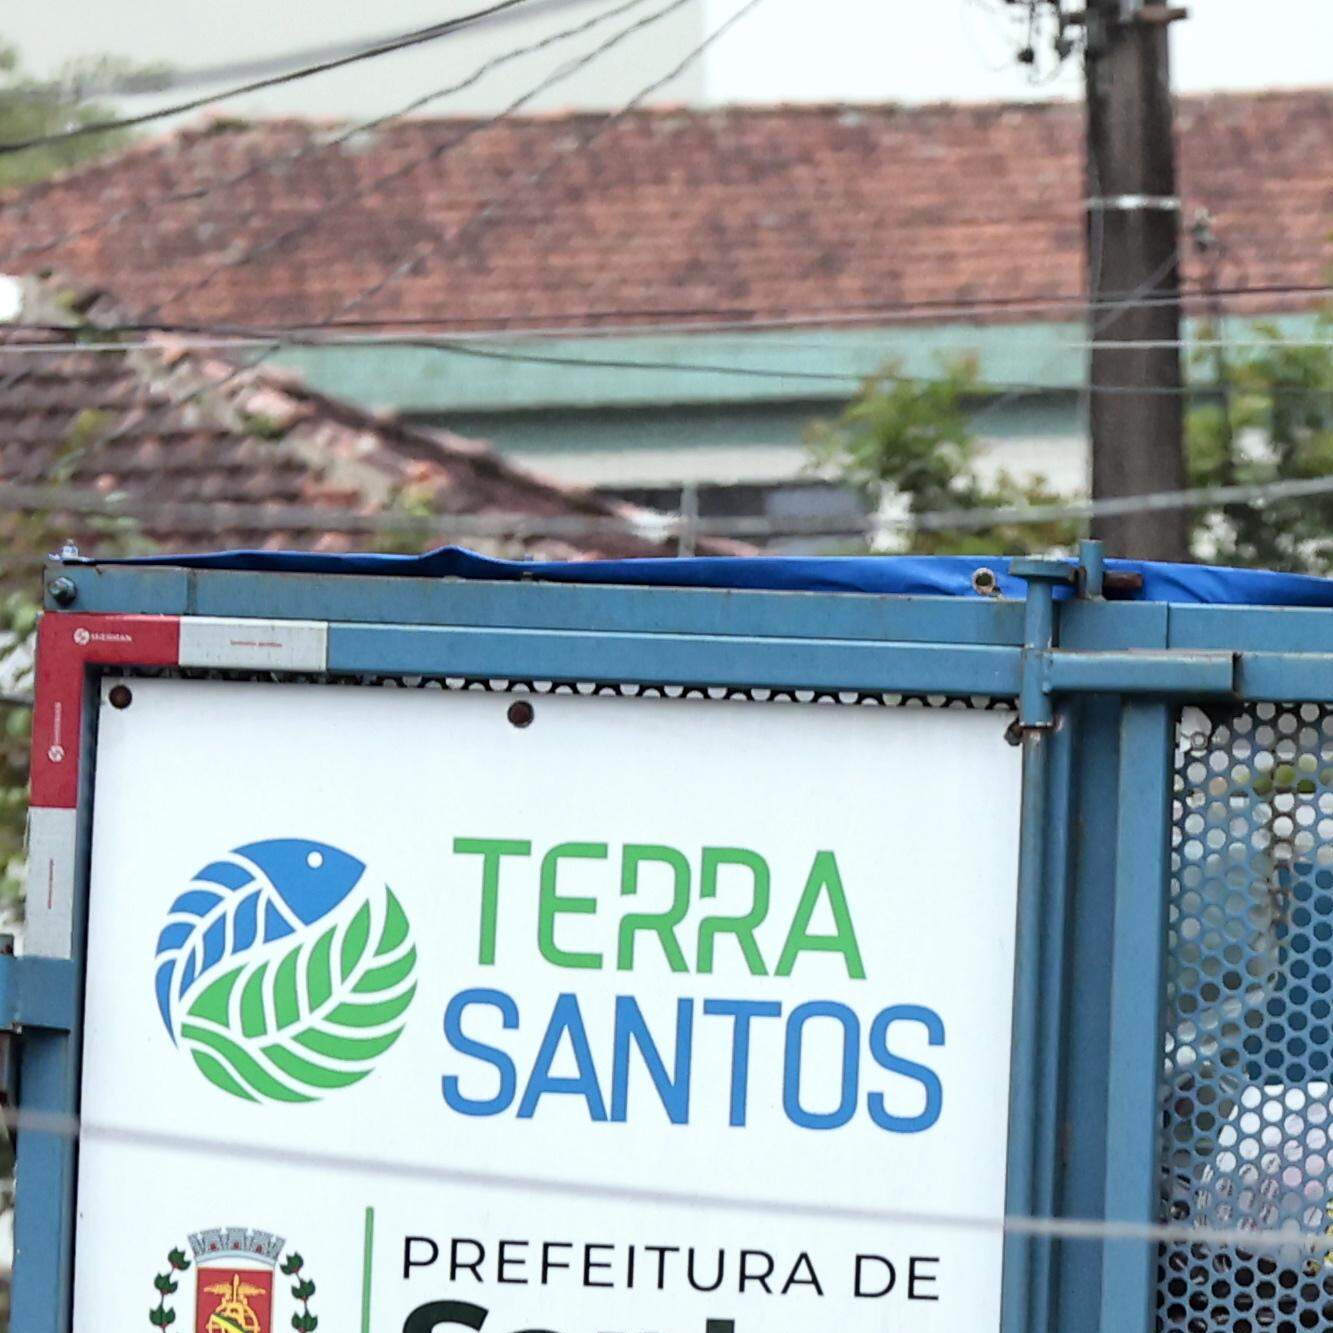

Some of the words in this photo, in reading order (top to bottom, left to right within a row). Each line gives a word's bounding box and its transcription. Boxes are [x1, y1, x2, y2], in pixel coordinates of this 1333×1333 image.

[453, 837, 866, 980] TERRA
[442, 988, 945, 1133] SANTOS
[402, 1236, 823, 1296] PREFEITURA
[853, 1254, 940, 1300] DE
